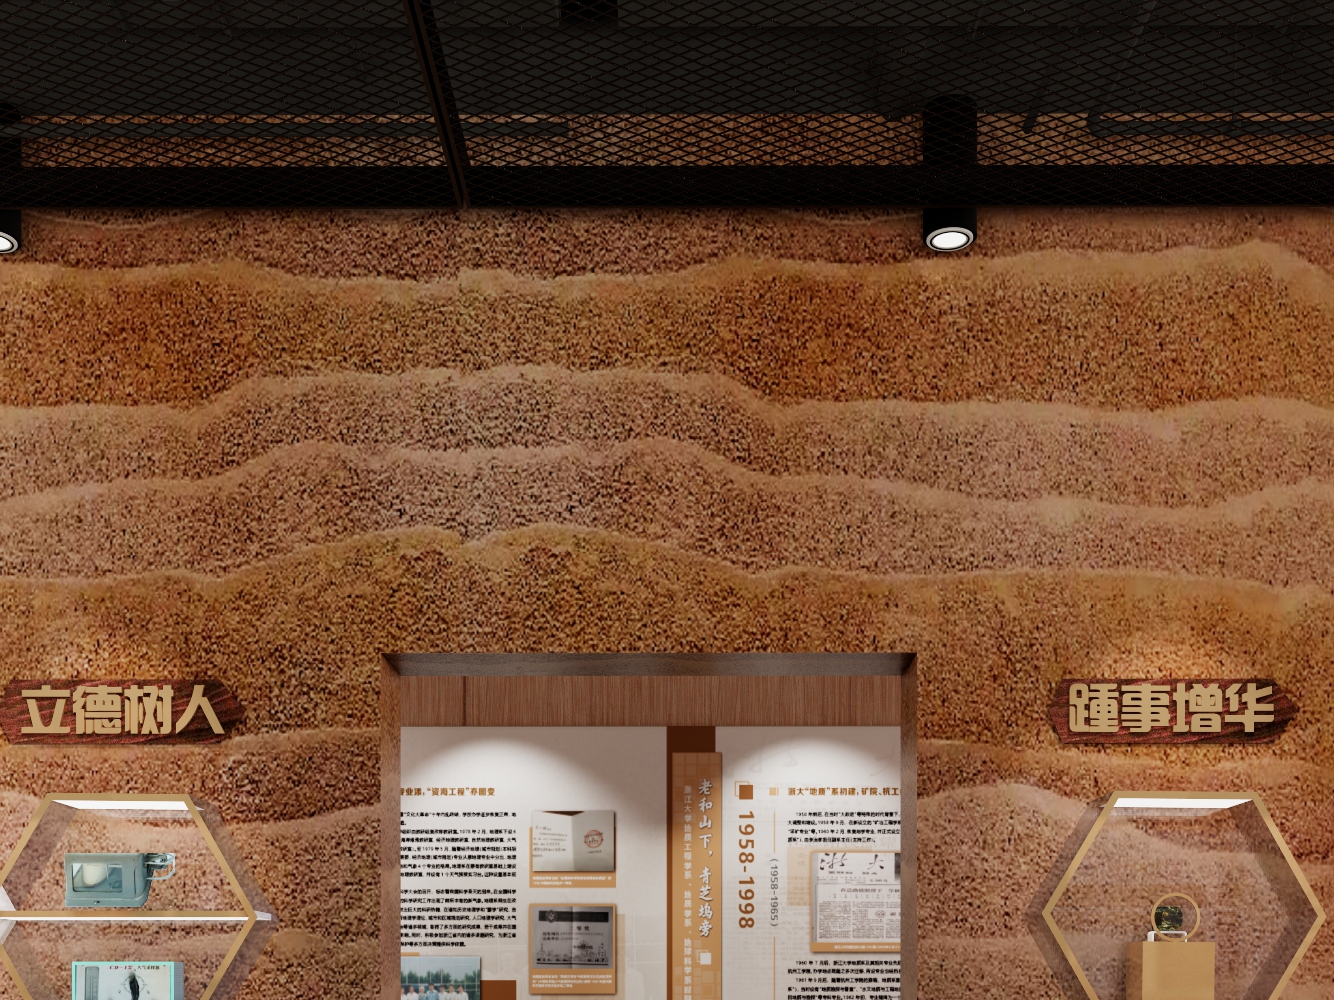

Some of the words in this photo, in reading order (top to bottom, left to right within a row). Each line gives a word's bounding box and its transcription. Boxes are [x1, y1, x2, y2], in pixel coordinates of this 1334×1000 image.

[20, 684, 226, 735] 立德树人
[1069, 682, 1275, 733] 踵事增华
[738, 811, 755, 929] 1958-1998
